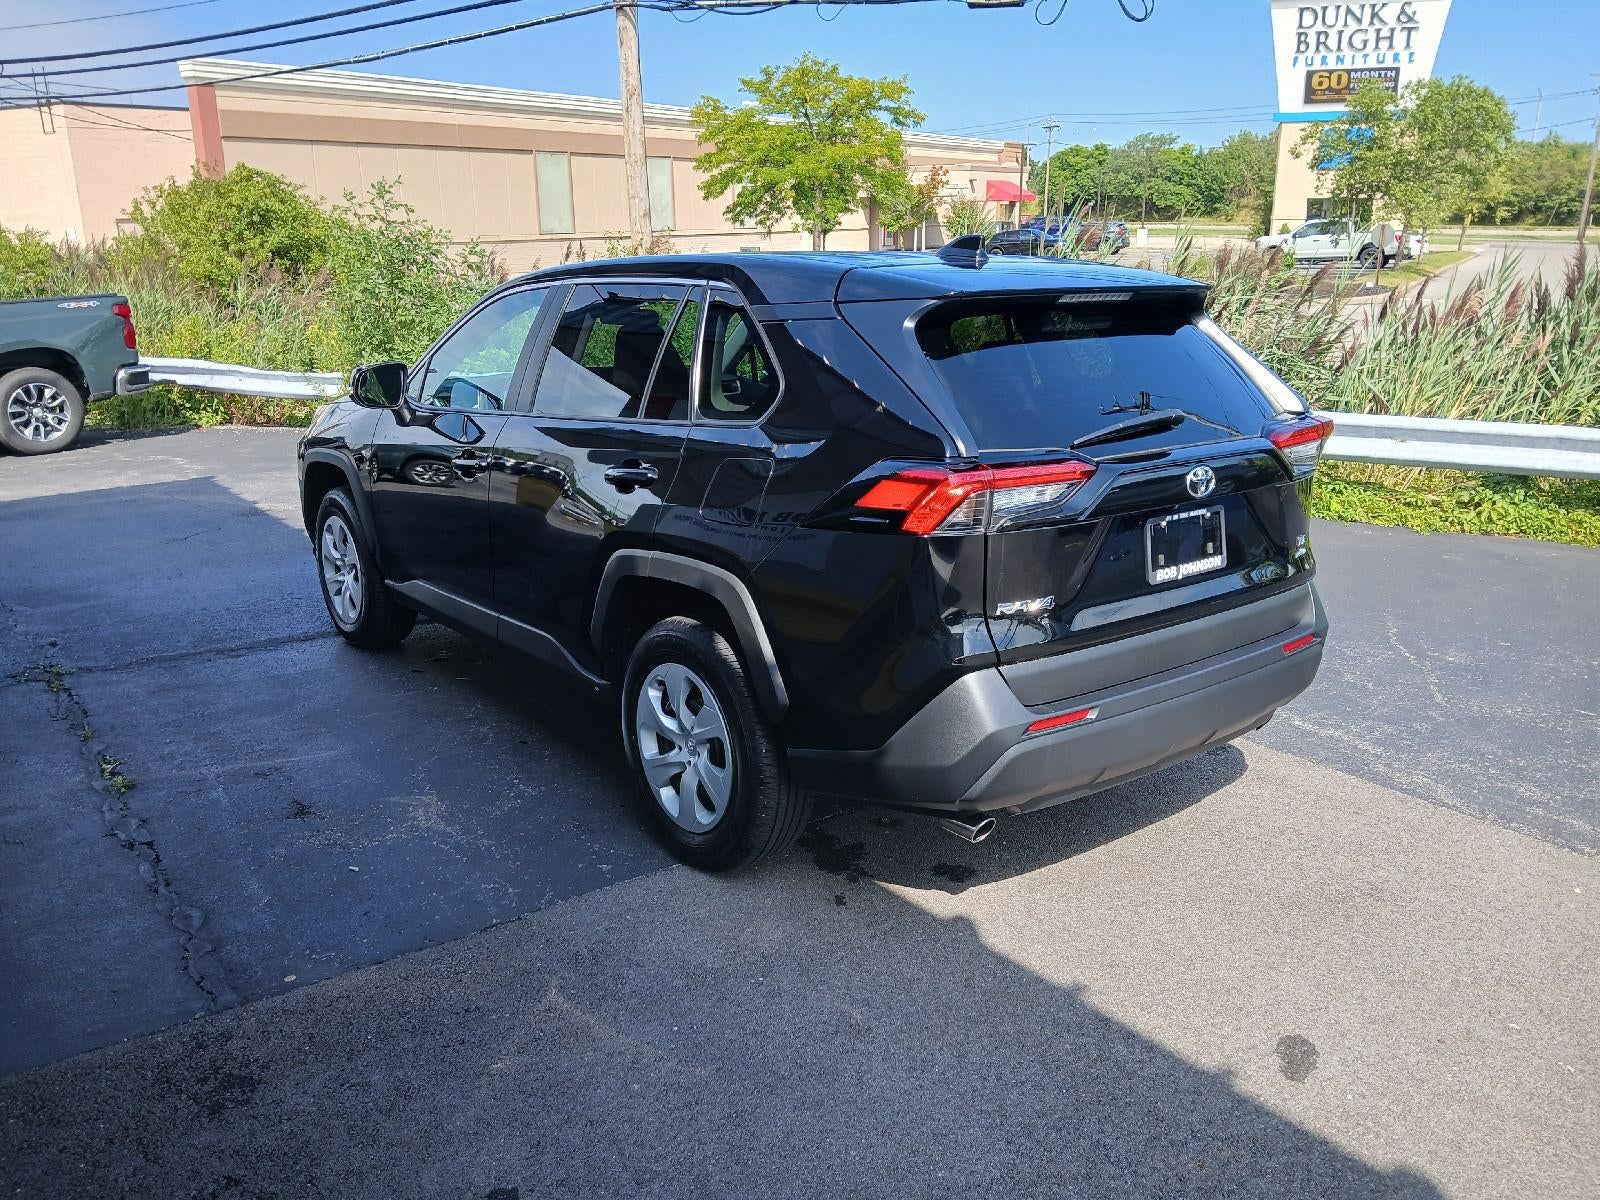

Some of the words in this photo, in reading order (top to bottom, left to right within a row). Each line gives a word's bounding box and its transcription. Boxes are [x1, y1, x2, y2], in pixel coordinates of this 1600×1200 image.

[1297, 3, 1389, 30] DUNK
[1396, 1, 1420, 25] &
[1295, 27, 1420, 54] BRIGHT
[1292, 52, 1416, 68] FURNITURE
[1311, 71, 1349, 90] 60
[1350, 70, 1396, 78] MONTH
[1156, 566, 1177, 581] BOB
[1177, 555, 1222, 579] JOHNSON
